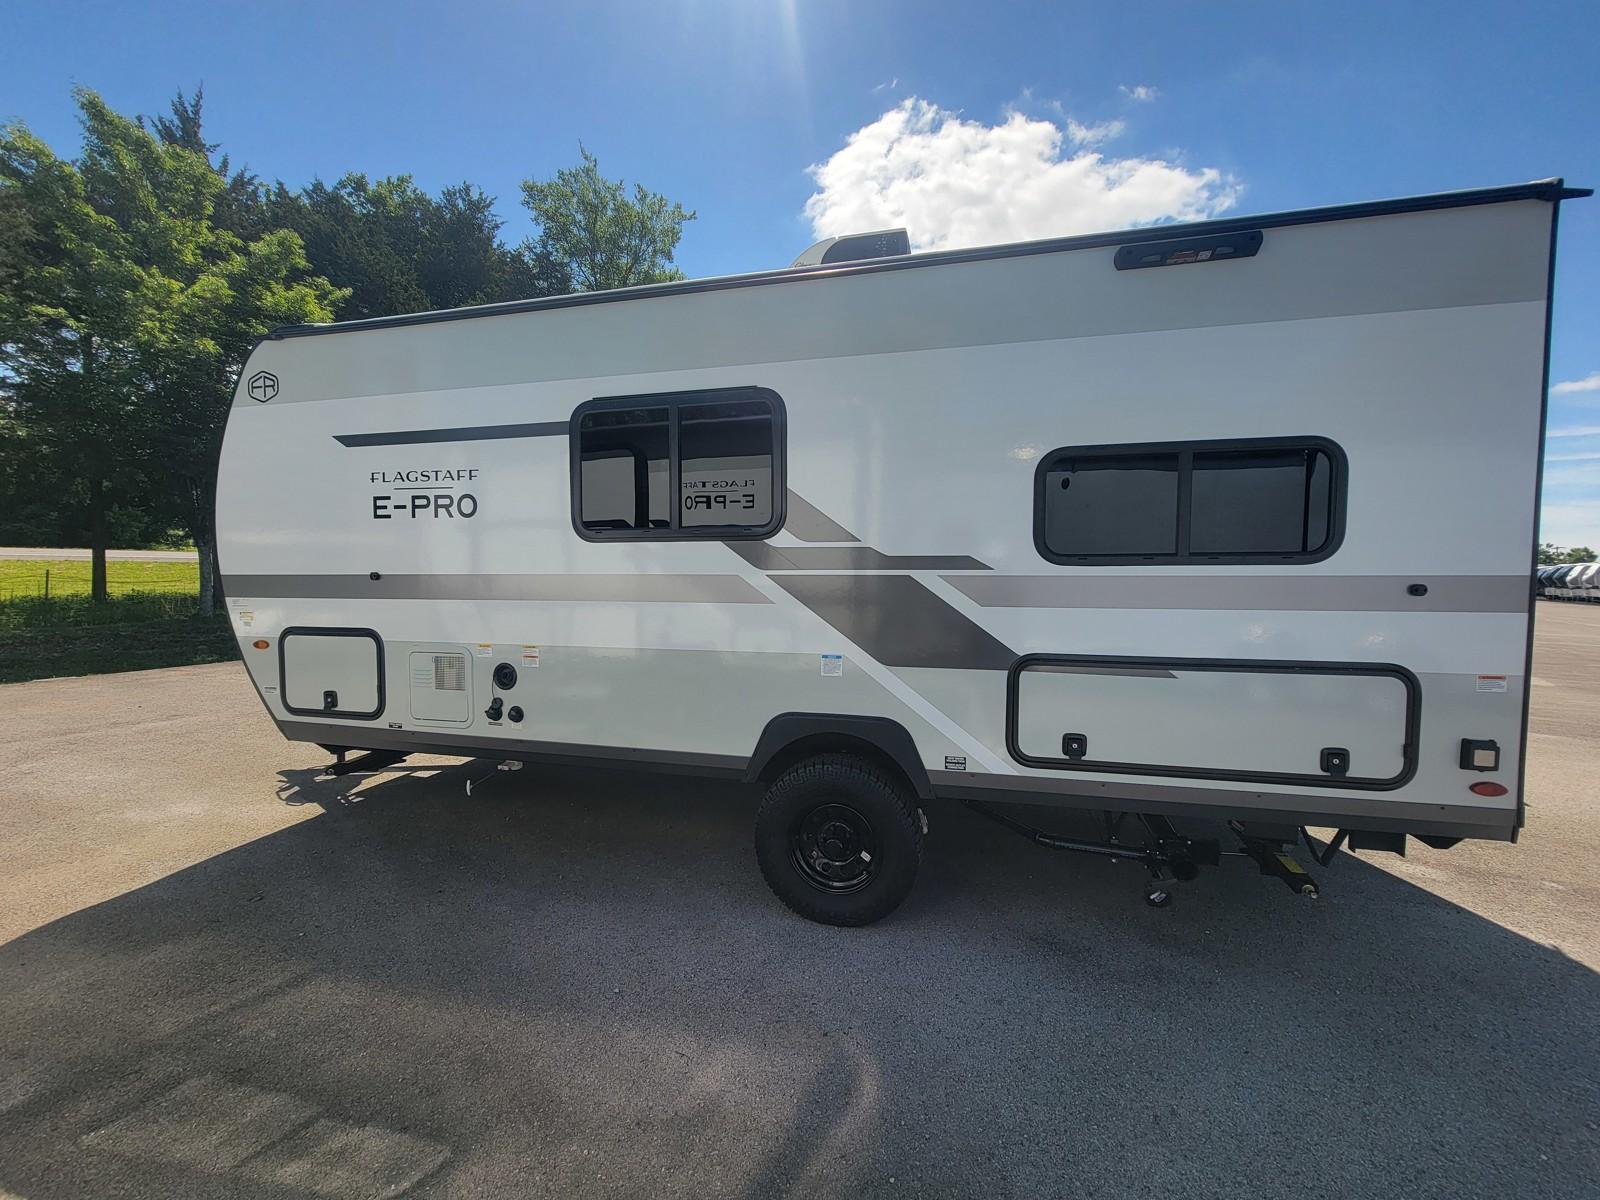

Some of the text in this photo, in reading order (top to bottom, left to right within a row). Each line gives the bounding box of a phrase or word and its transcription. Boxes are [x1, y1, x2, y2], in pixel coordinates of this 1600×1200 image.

[250, 374, 277, 399] FR
[370, 469, 479, 483] FLAGSTAFF
[372, 493, 478, 519] E-PRO
